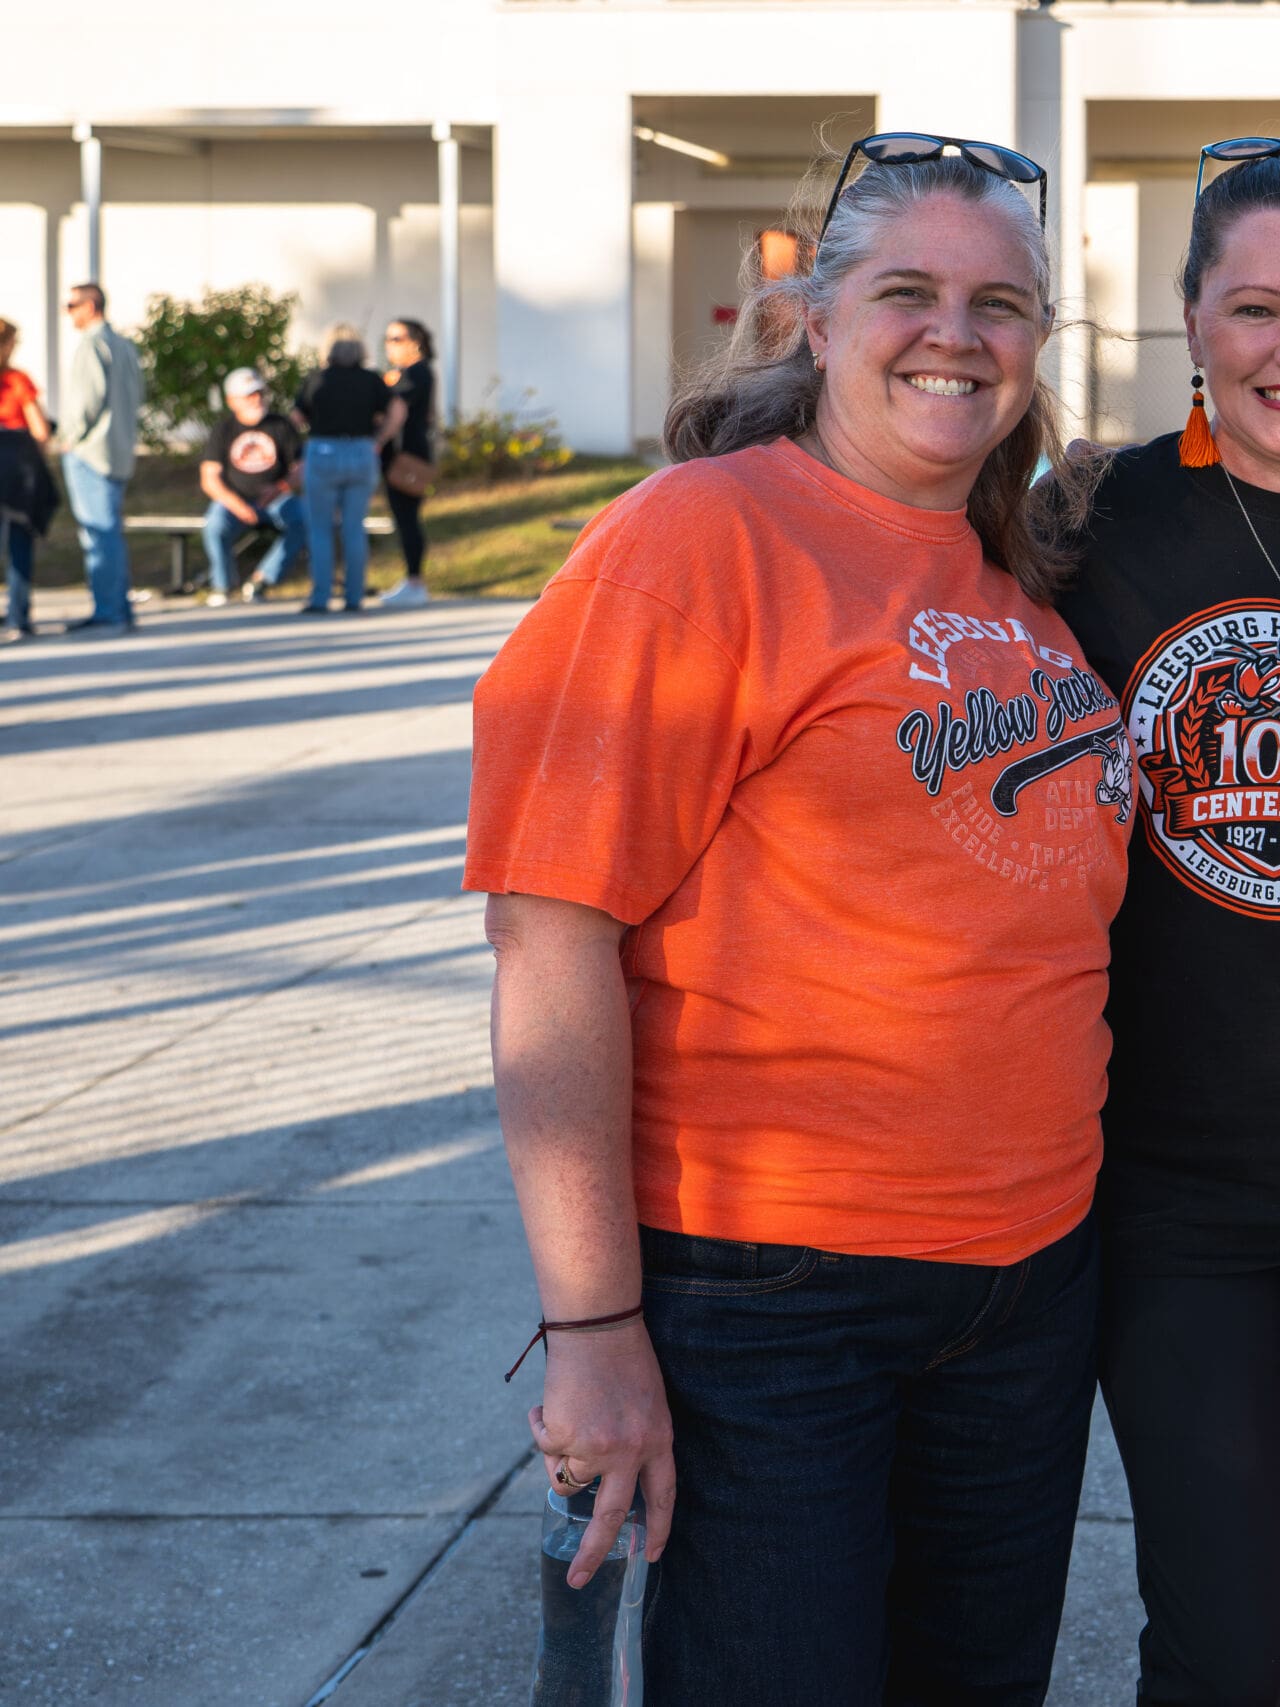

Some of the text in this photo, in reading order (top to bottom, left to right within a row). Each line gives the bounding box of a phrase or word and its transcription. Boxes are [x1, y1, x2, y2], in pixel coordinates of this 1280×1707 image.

[1139, 617, 1260, 711] LEESBURG
[896, 686, 1038, 796] Yellow
[952, 781, 1004, 845] PRIDE
[1045, 807, 1096, 832] DEPT
[1046, 780, 1091, 804] ATH
[931, 795, 1050, 889] EXCELLENCE
[1226, 826, 1266, 850] 1927
[1186, 849, 1280, 903] LEESBURG,
